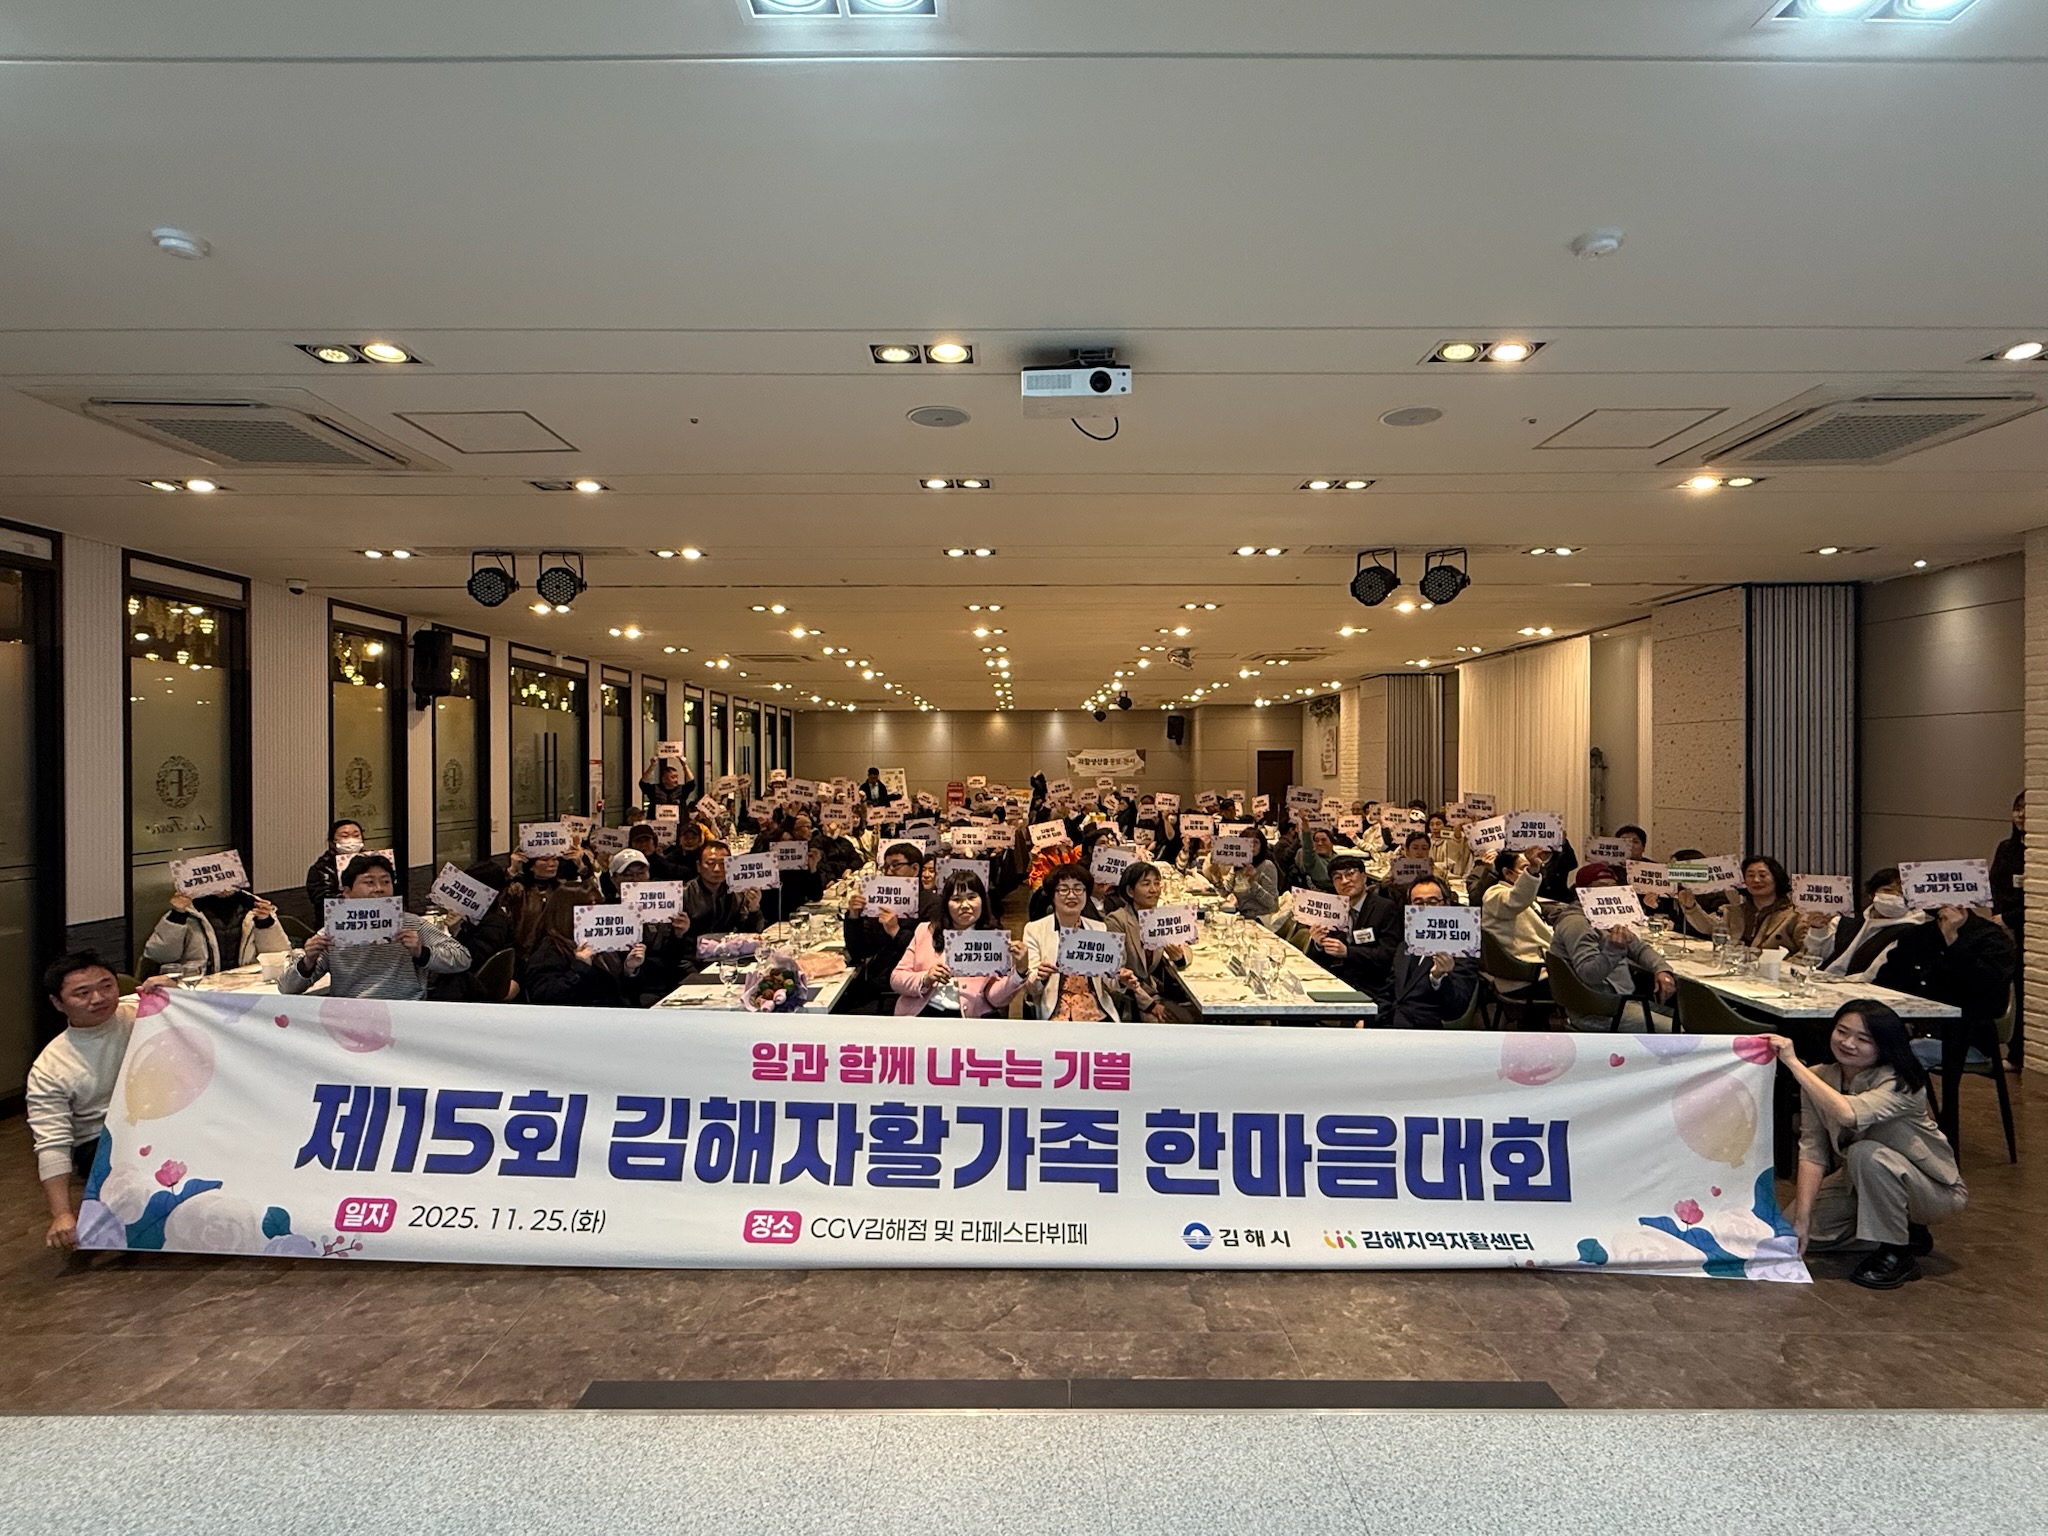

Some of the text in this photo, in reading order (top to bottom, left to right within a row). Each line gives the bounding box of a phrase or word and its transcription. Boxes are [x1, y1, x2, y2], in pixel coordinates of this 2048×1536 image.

[1520, 821, 1546, 831] 자활이
[1511, 830, 1556, 839] 날개가 되어
[1925, 871, 1963, 882] 자활이
[877, 886, 902, 896] 자활이
[1806, 883, 1832, 894] 자활이
[1913, 881, 1978, 894] 날개가 되어
[868, 895, 911, 906] 날개가 되어
[1597, 896, 1622, 906] 자활이
[1799, 892, 1844, 904] 날개가 되어
[347, 908, 380, 919] 자활이
[1590, 904, 1634, 917] 날개가 되어
[335, 918, 393, 931] 날개가 되어
[594, 916, 624, 926] 자활이
[1156, 915, 1182, 927] 자활이
[1427, 918, 1459, 929] 자활이
[584, 926, 634, 938] 날개가 되어
[1148, 924, 1191, 938] 날개가 되어
[1415, 929, 1471, 941] 날개가 되어
[964, 942, 992, 951] 자활이
[1077, 940, 1105, 952] 자활이
[954, 951, 1003, 963] 날개가 되어
[1066, 949, 1115, 964] 날개가 되어
[751, 1042, 1131, 1091] 일과 함께 나누는 기쁨
[295, 1083, 1573, 1202] 제15회 김해자활가족 한마음대회
[342, 1201, 392, 1228] 일자
[407, 1205, 607, 1235] 2025. 11. 25.(화)
[750, 1213, 796, 1240] 장소
[810, 1216, 1089, 1246] CGV김해점 및 라페스타뷔페
[1361, 1228, 1535, 1252] 김해지역자활센터
